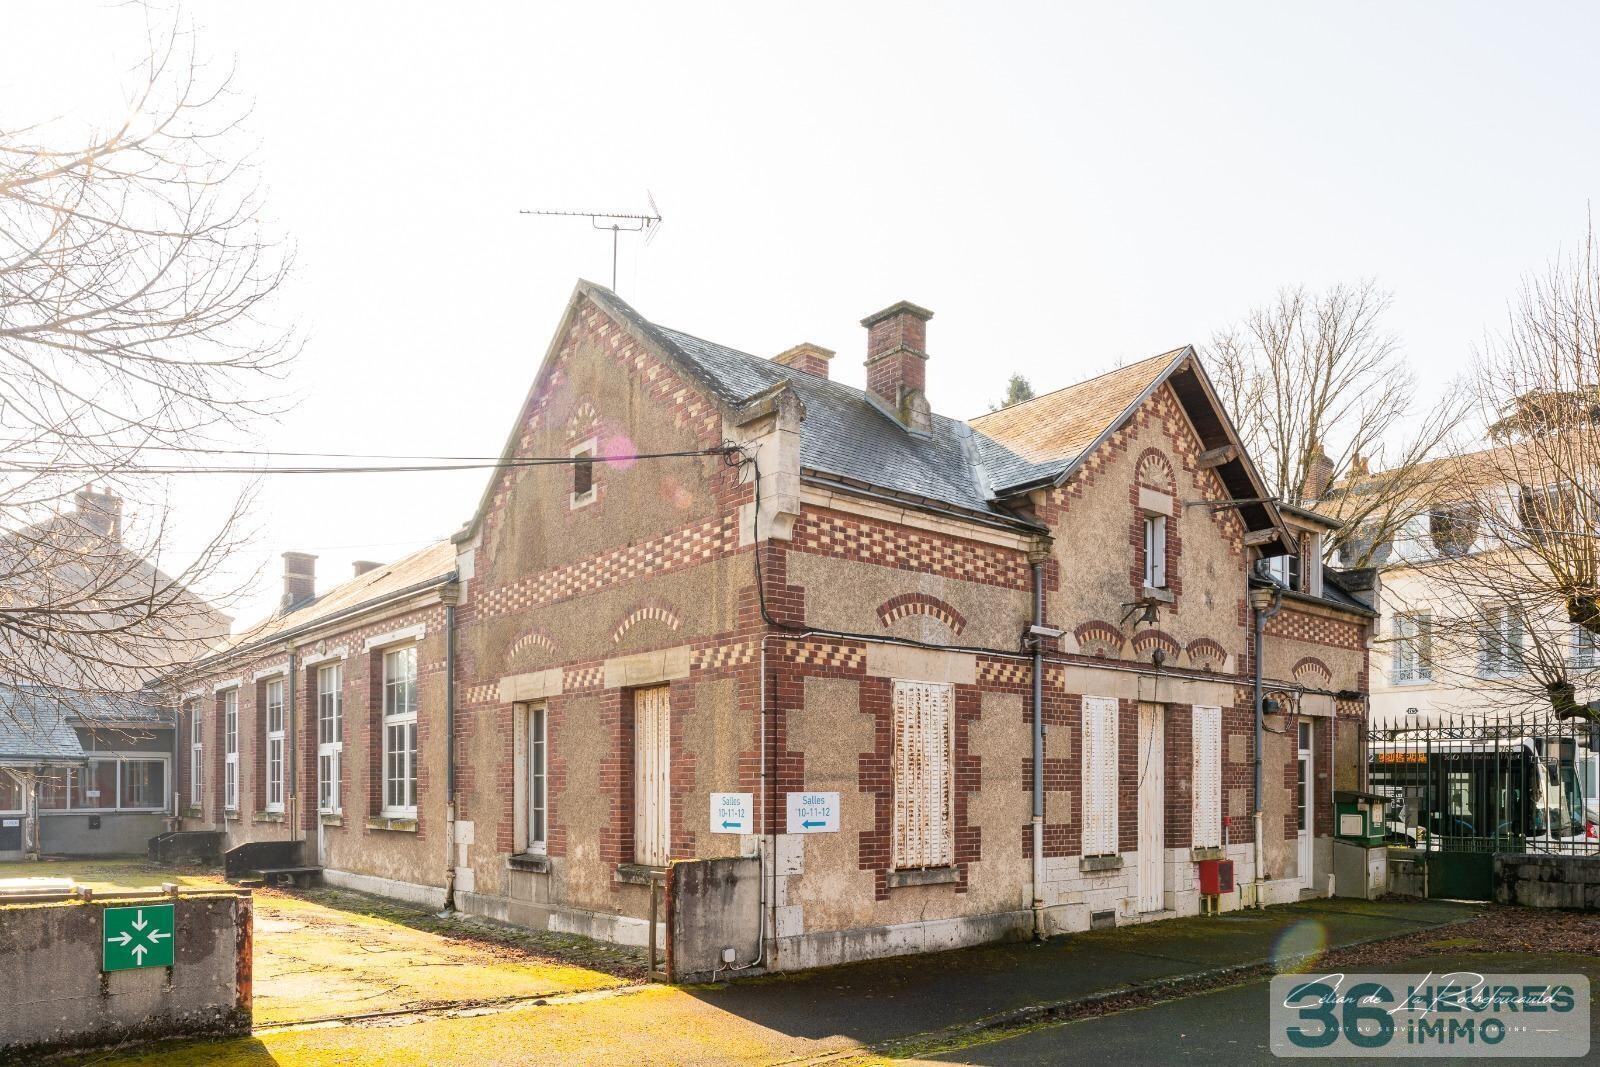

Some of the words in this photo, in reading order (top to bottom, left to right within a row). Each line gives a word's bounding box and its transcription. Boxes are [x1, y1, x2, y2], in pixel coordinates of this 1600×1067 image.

[722, 796, 741, 806] Salles
[802, 795, 825, 805] Salles
[718, 808, 745, 818] 10-11-12
[797, 807, 831, 817] 10-11-12
